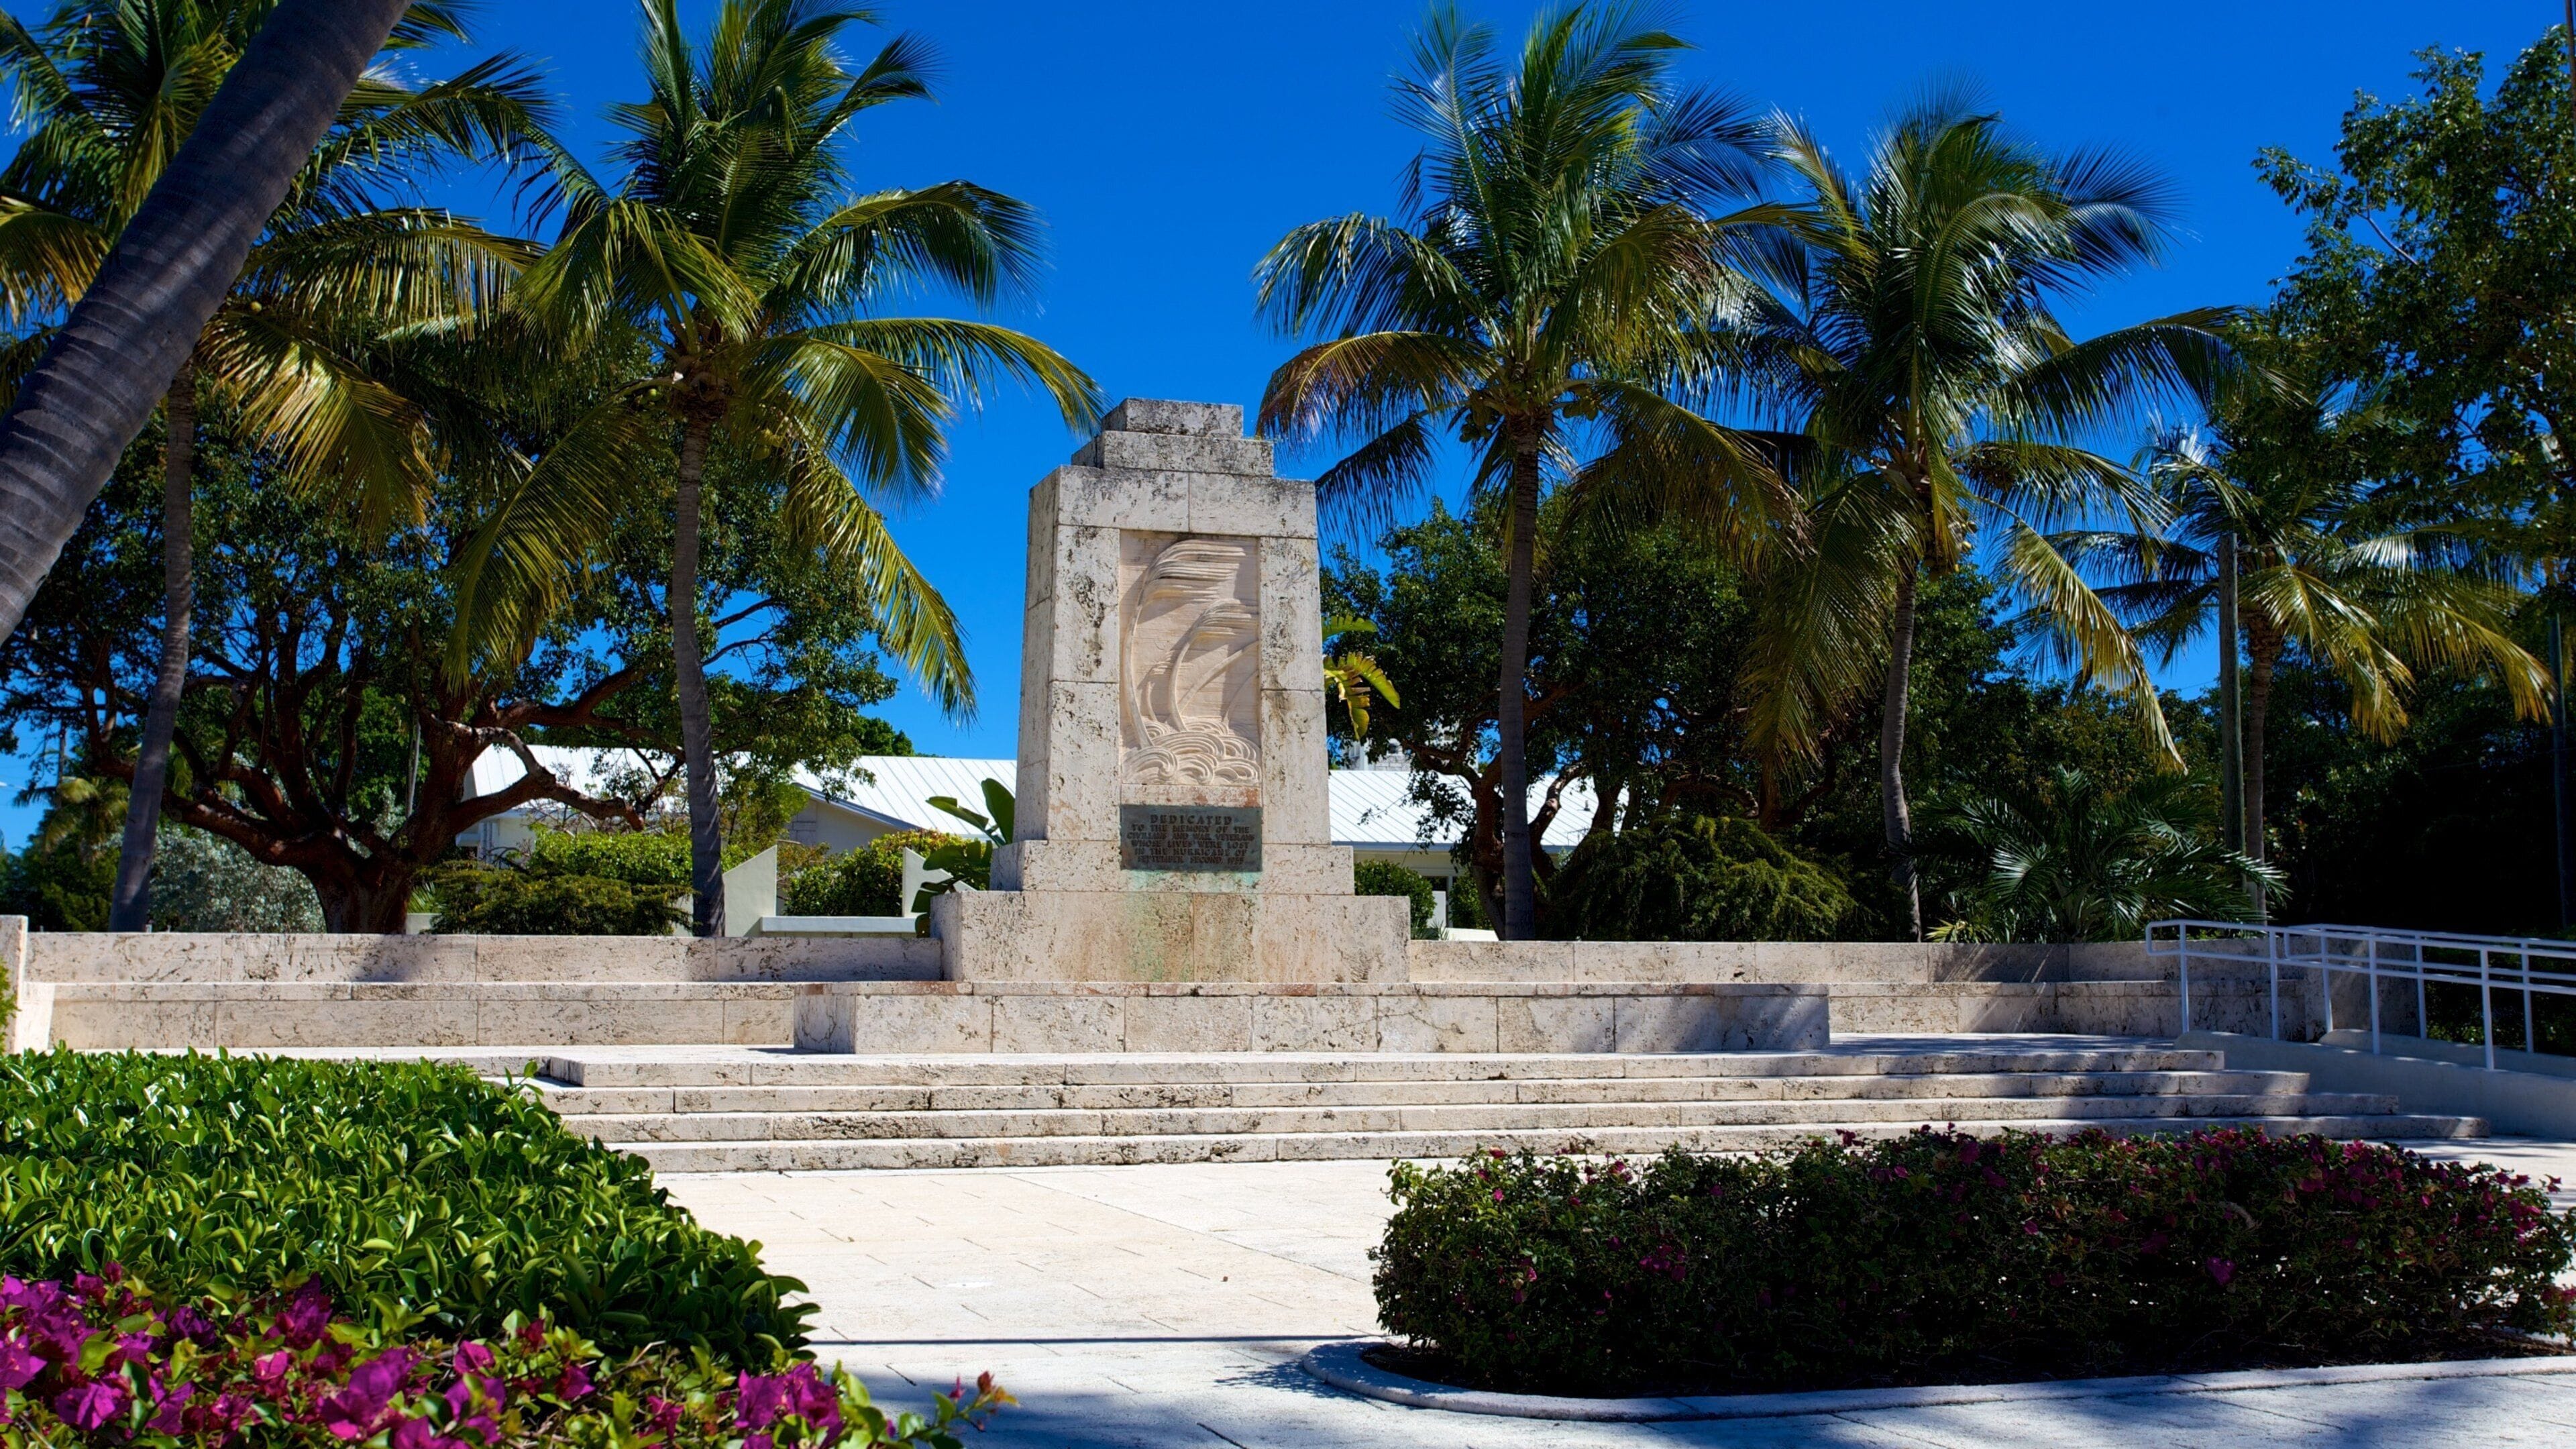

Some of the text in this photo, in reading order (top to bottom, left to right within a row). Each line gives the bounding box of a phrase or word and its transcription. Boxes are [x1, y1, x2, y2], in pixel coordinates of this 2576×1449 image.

[1150, 814, 1232, 825] DEDICATED
[1132, 824, 1144, 832] TO
[1173, 824, 1209, 833] MEMORY
[1234, 826, 1250, 834] THE
[1131, 839, 1163, 847] WHOSE
[1168, 840, 1192, 848] LIVES
[1227, 841, 1250, 849] LOST
[1135, 847, 1247, 857] IN THE HURRICANE OF
